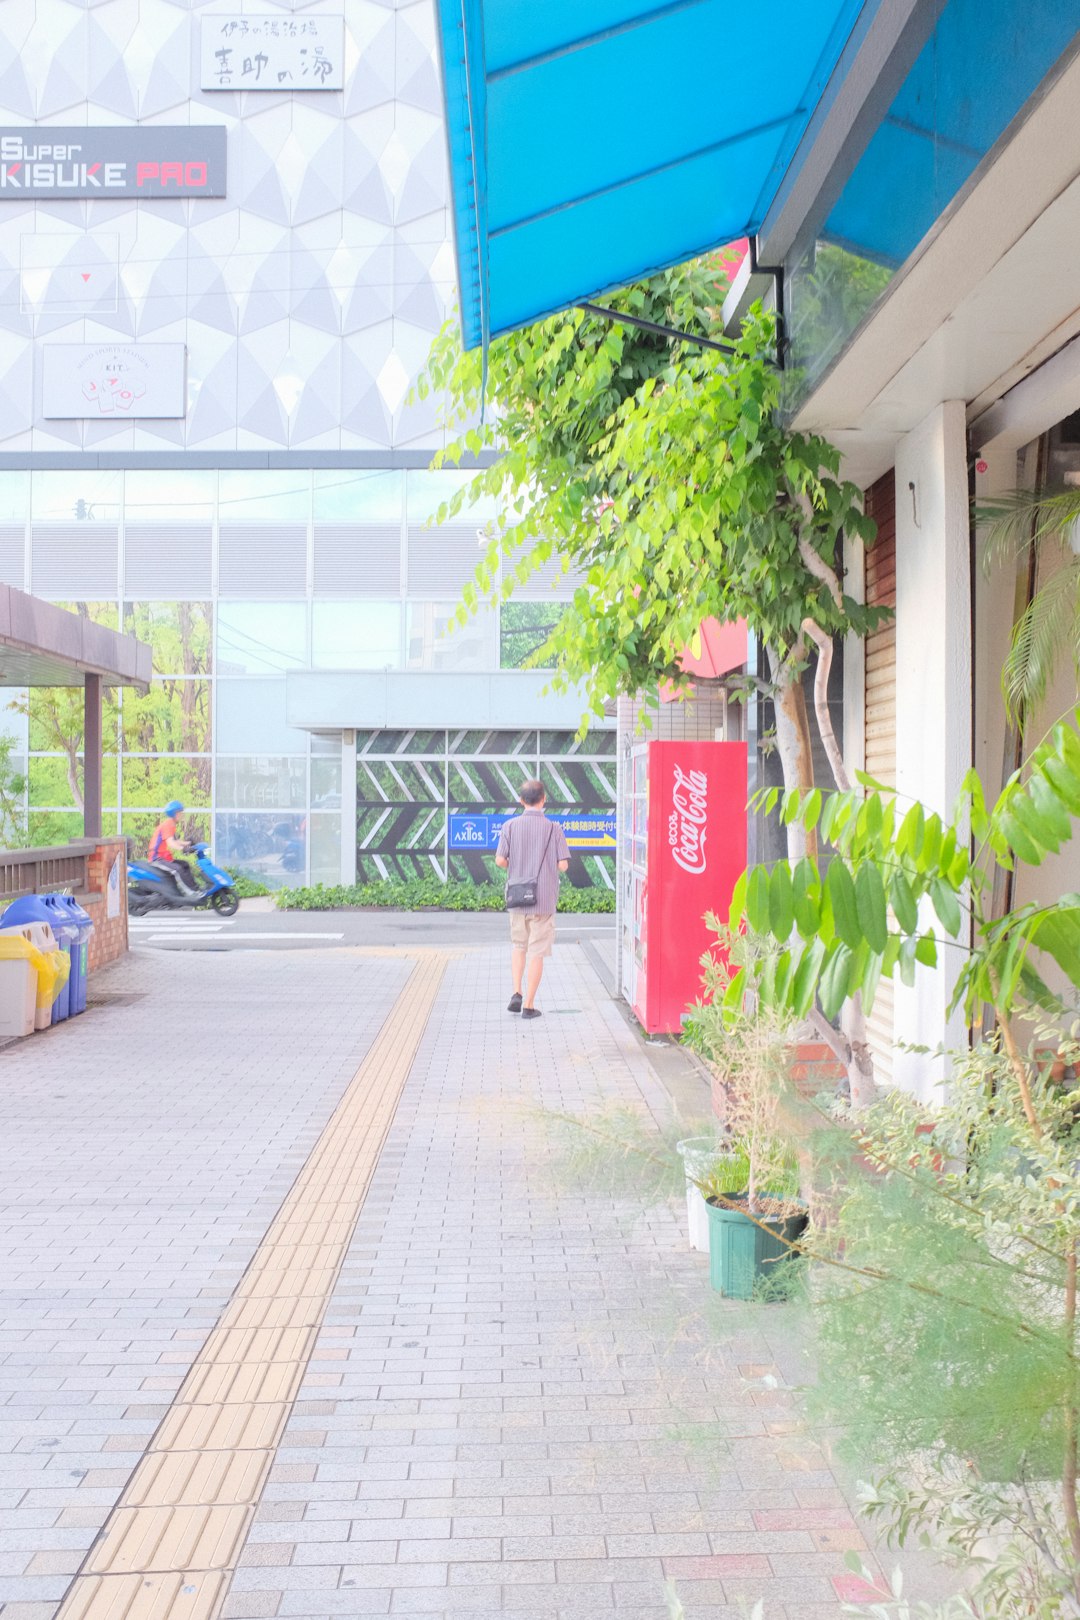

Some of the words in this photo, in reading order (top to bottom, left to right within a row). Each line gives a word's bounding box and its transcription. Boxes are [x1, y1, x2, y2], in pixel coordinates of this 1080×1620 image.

[220, 20, 318, 38] 伊予の湯治場
[214, 46, 333, 85] 喜助の湯
[1, 163, 127, 188] KISUKE
[672, 763, 708, 874] Coca-Cola
